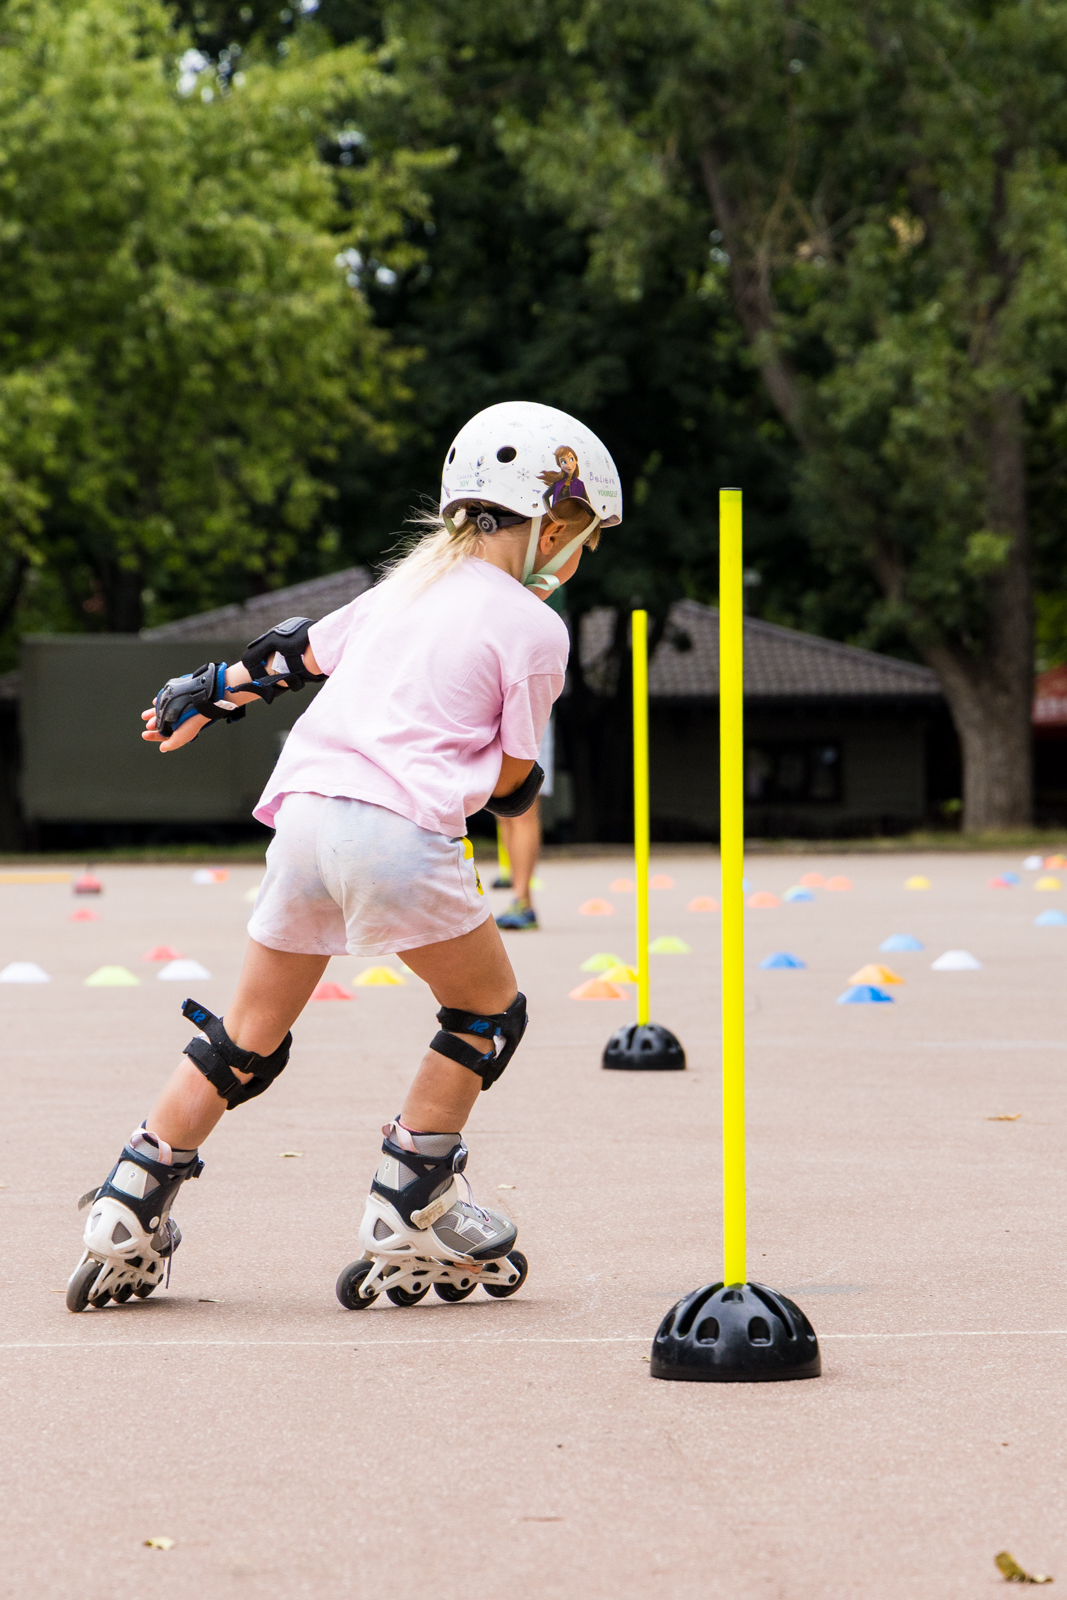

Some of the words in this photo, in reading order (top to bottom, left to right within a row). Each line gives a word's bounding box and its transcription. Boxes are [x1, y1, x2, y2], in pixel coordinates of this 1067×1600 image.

[589, 472, 616, 485] Believe
[597, 489, 618, 498] YOURSELF
[468, 1019, 490, 1034] K2
